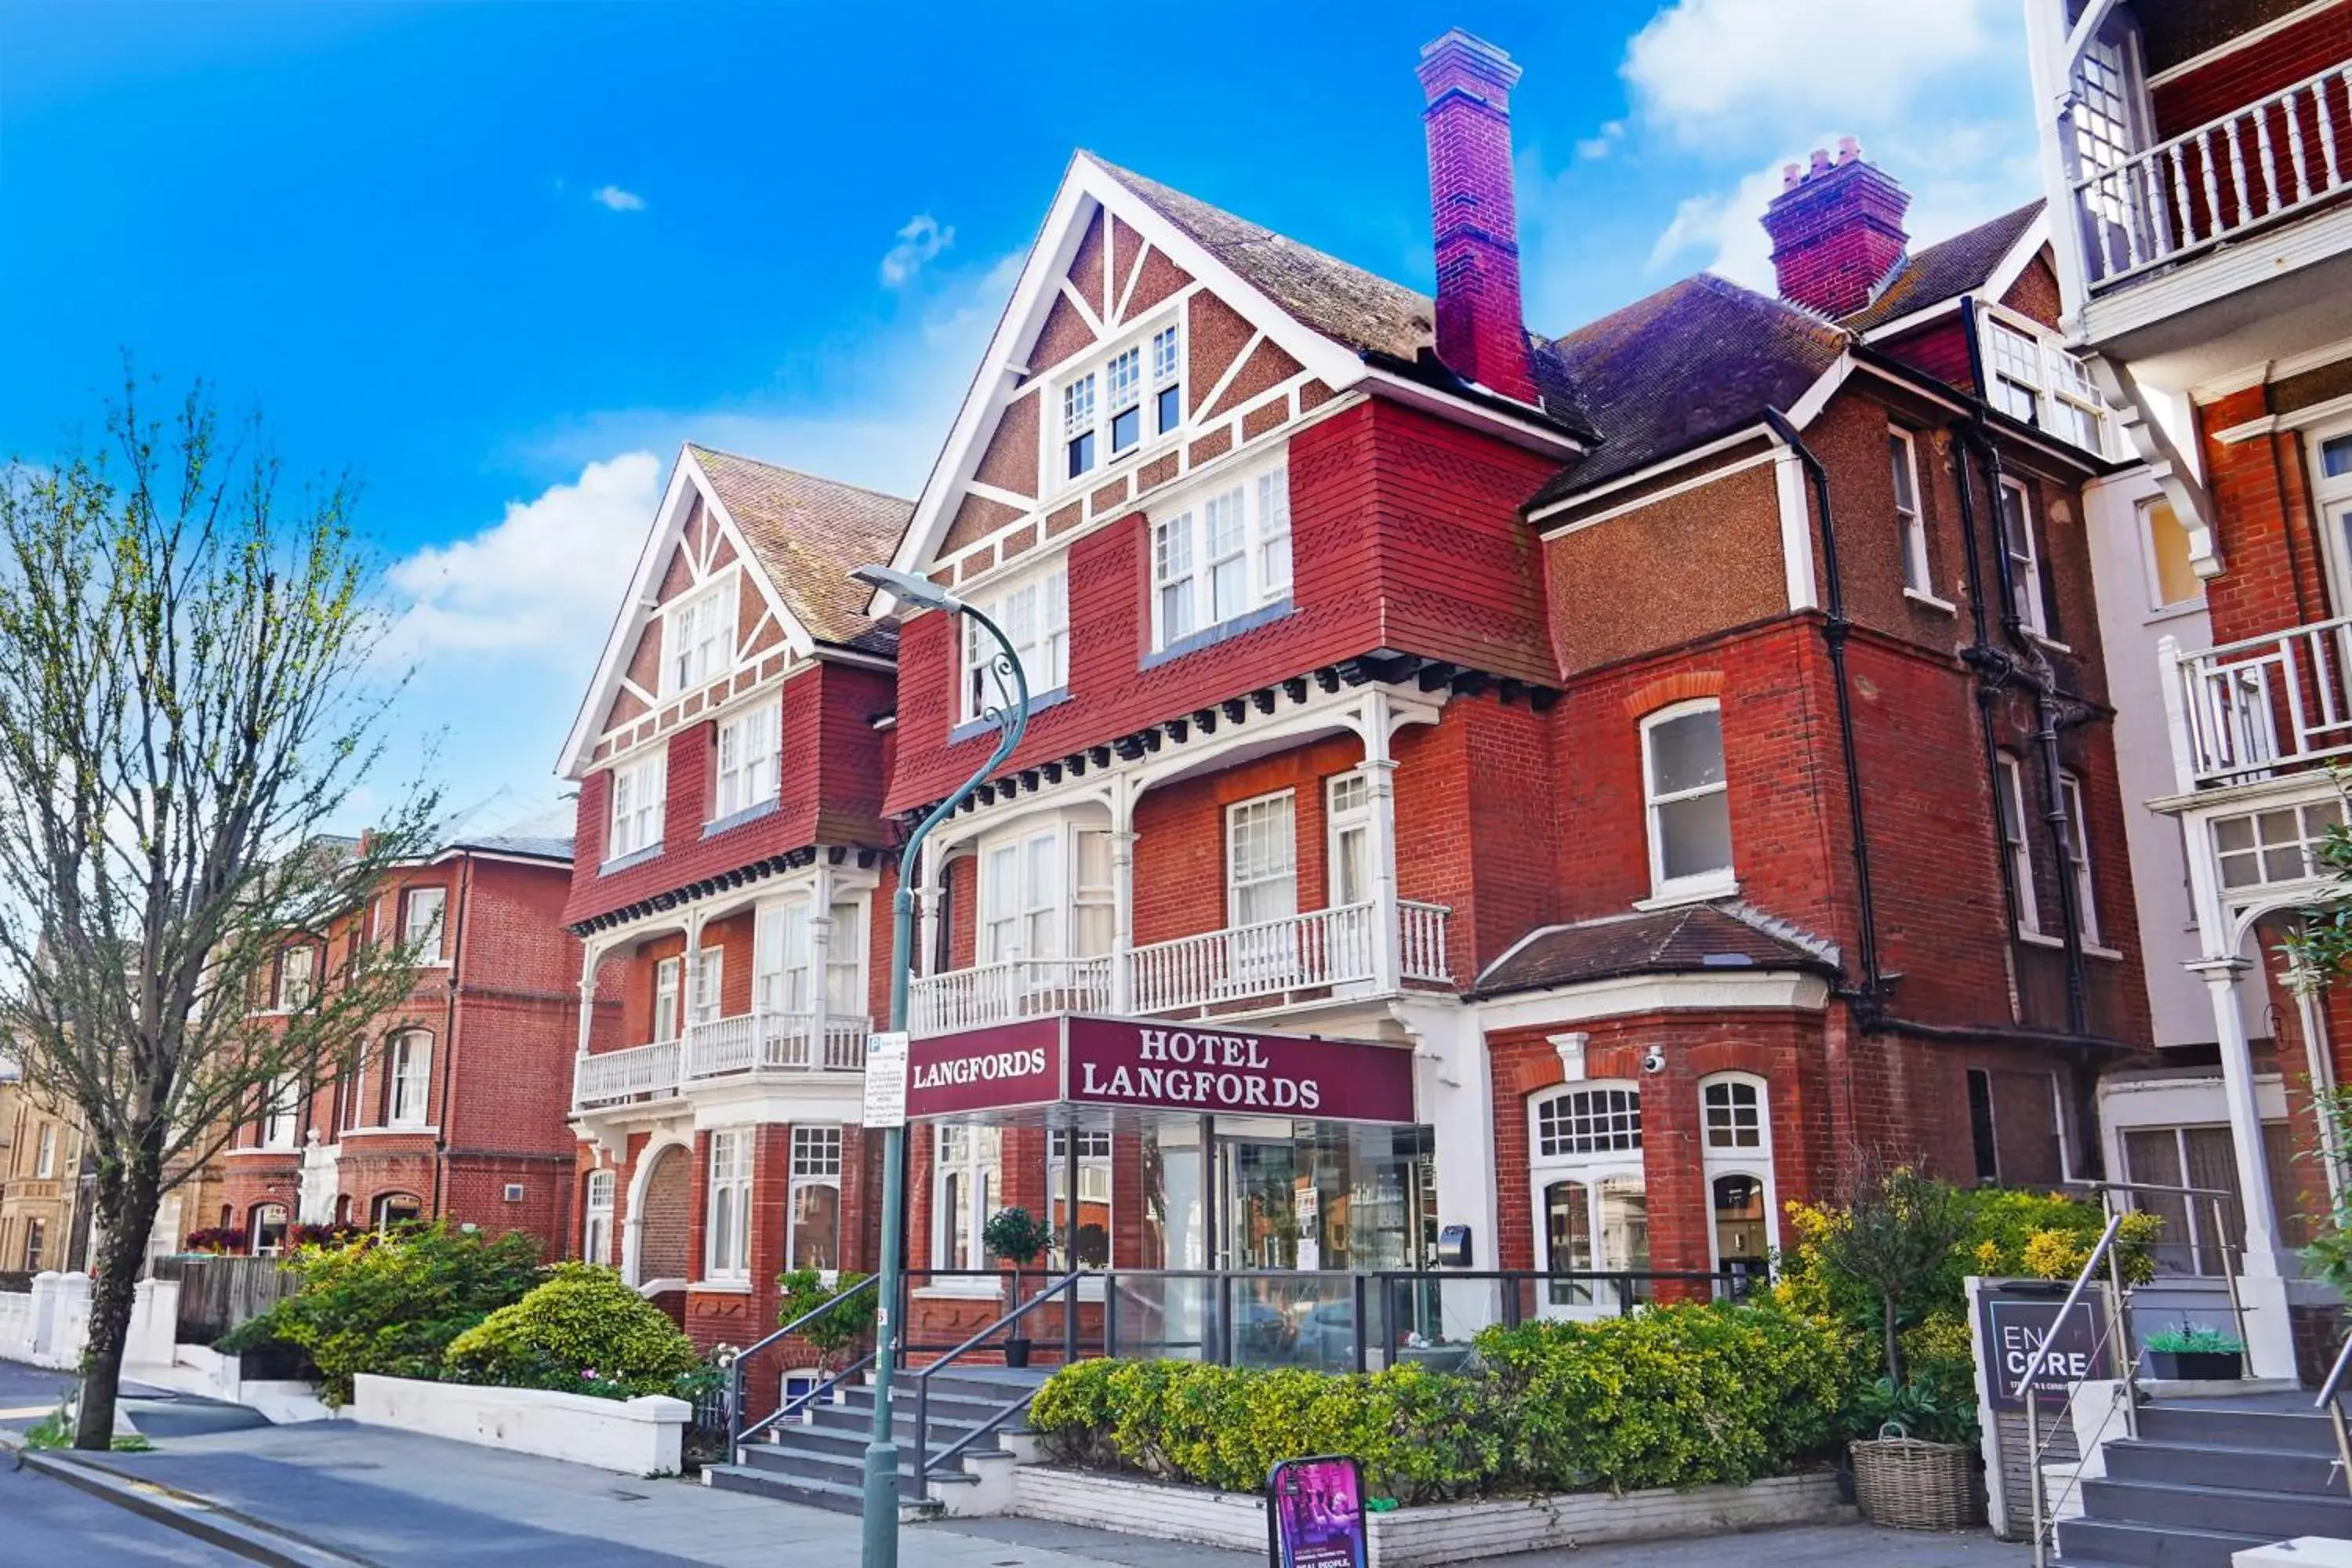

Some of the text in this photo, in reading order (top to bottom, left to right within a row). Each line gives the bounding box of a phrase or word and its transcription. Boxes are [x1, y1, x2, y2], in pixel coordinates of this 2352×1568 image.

[913, 1047, 1046, 1089] LANGFORDS
[1139, 1029, 1269, 1069] HOTEL
[1082, 1062, 1319, 1109] LANGFORDS
[2004, 1326, 2044, 1349] EN
